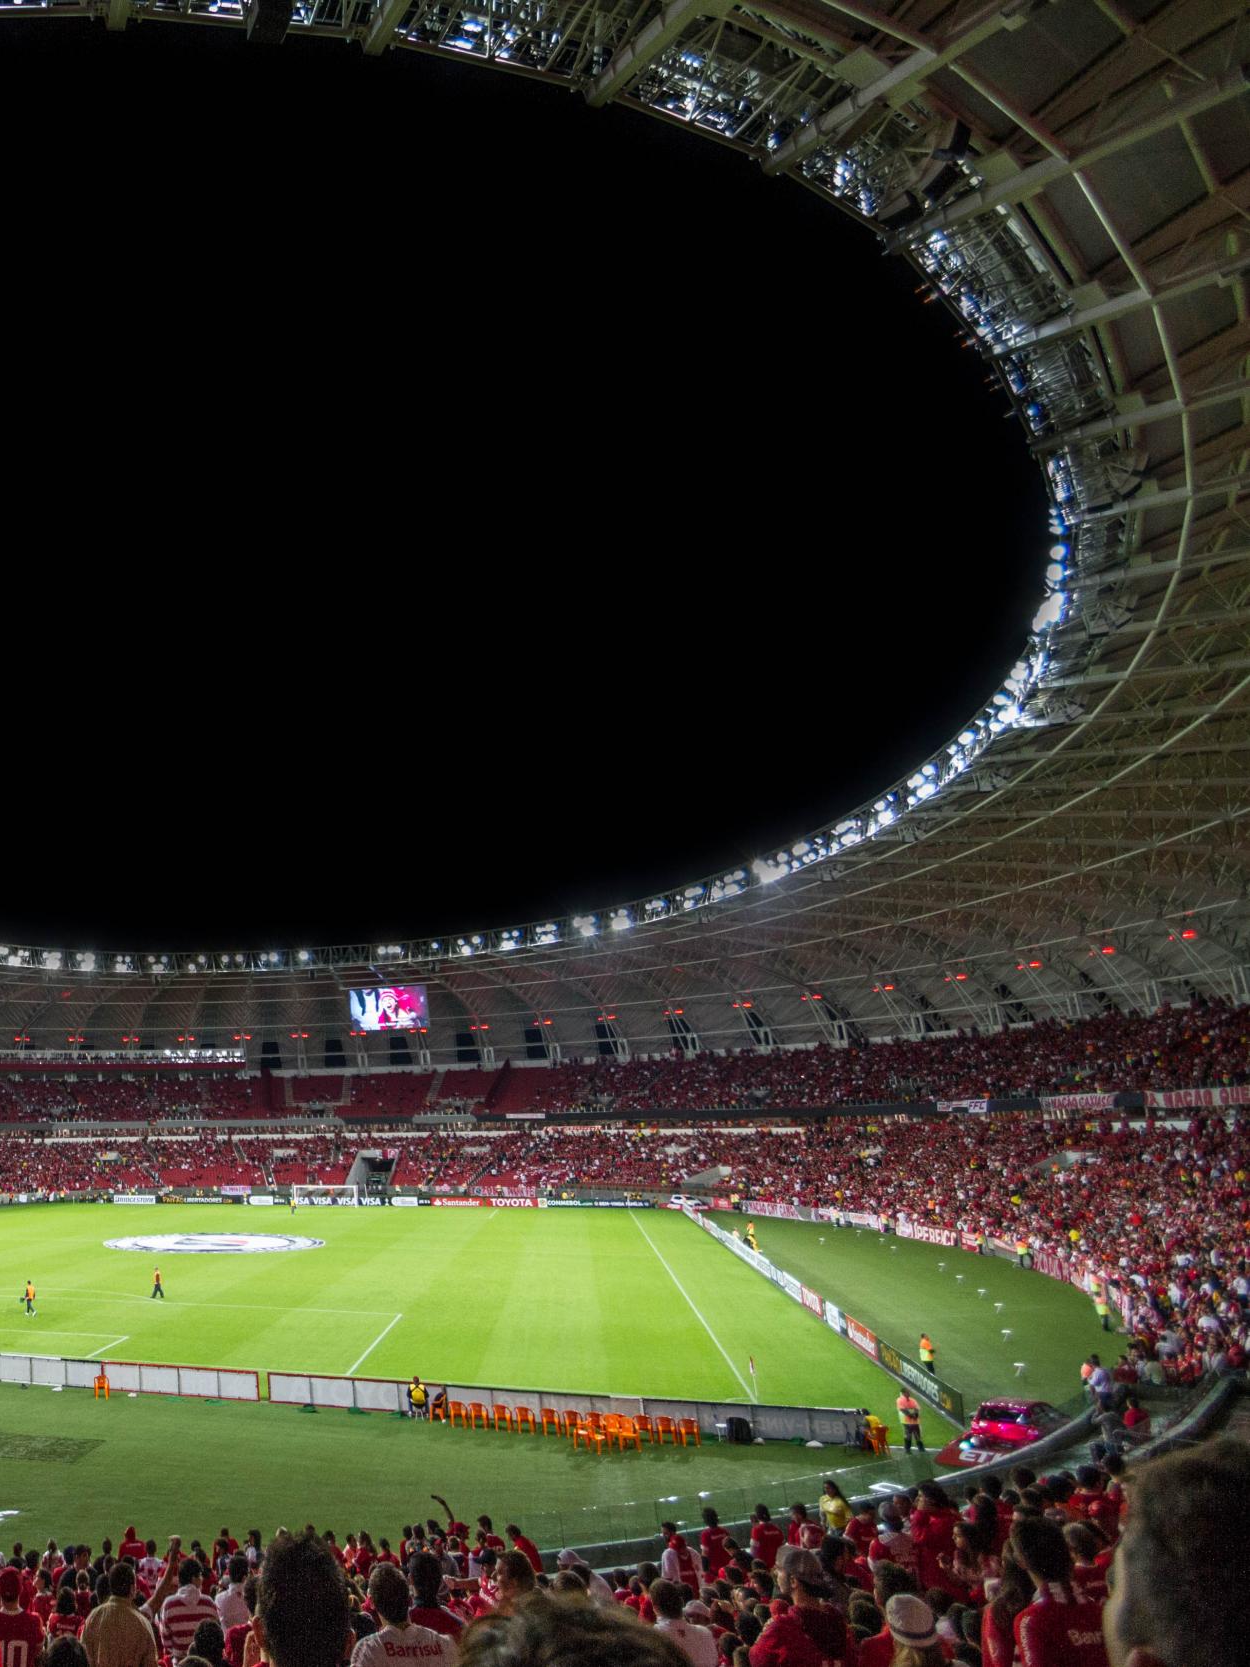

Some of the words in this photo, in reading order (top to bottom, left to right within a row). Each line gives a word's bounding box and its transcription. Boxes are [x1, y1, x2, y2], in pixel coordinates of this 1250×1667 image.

[313, 1197, 333, 1205] VISA
[361, 1197, 381, 1205] VISA
[442, 1197, 480, 1206] Santander
[490, 1198, 533, 1207] TOYOTA
